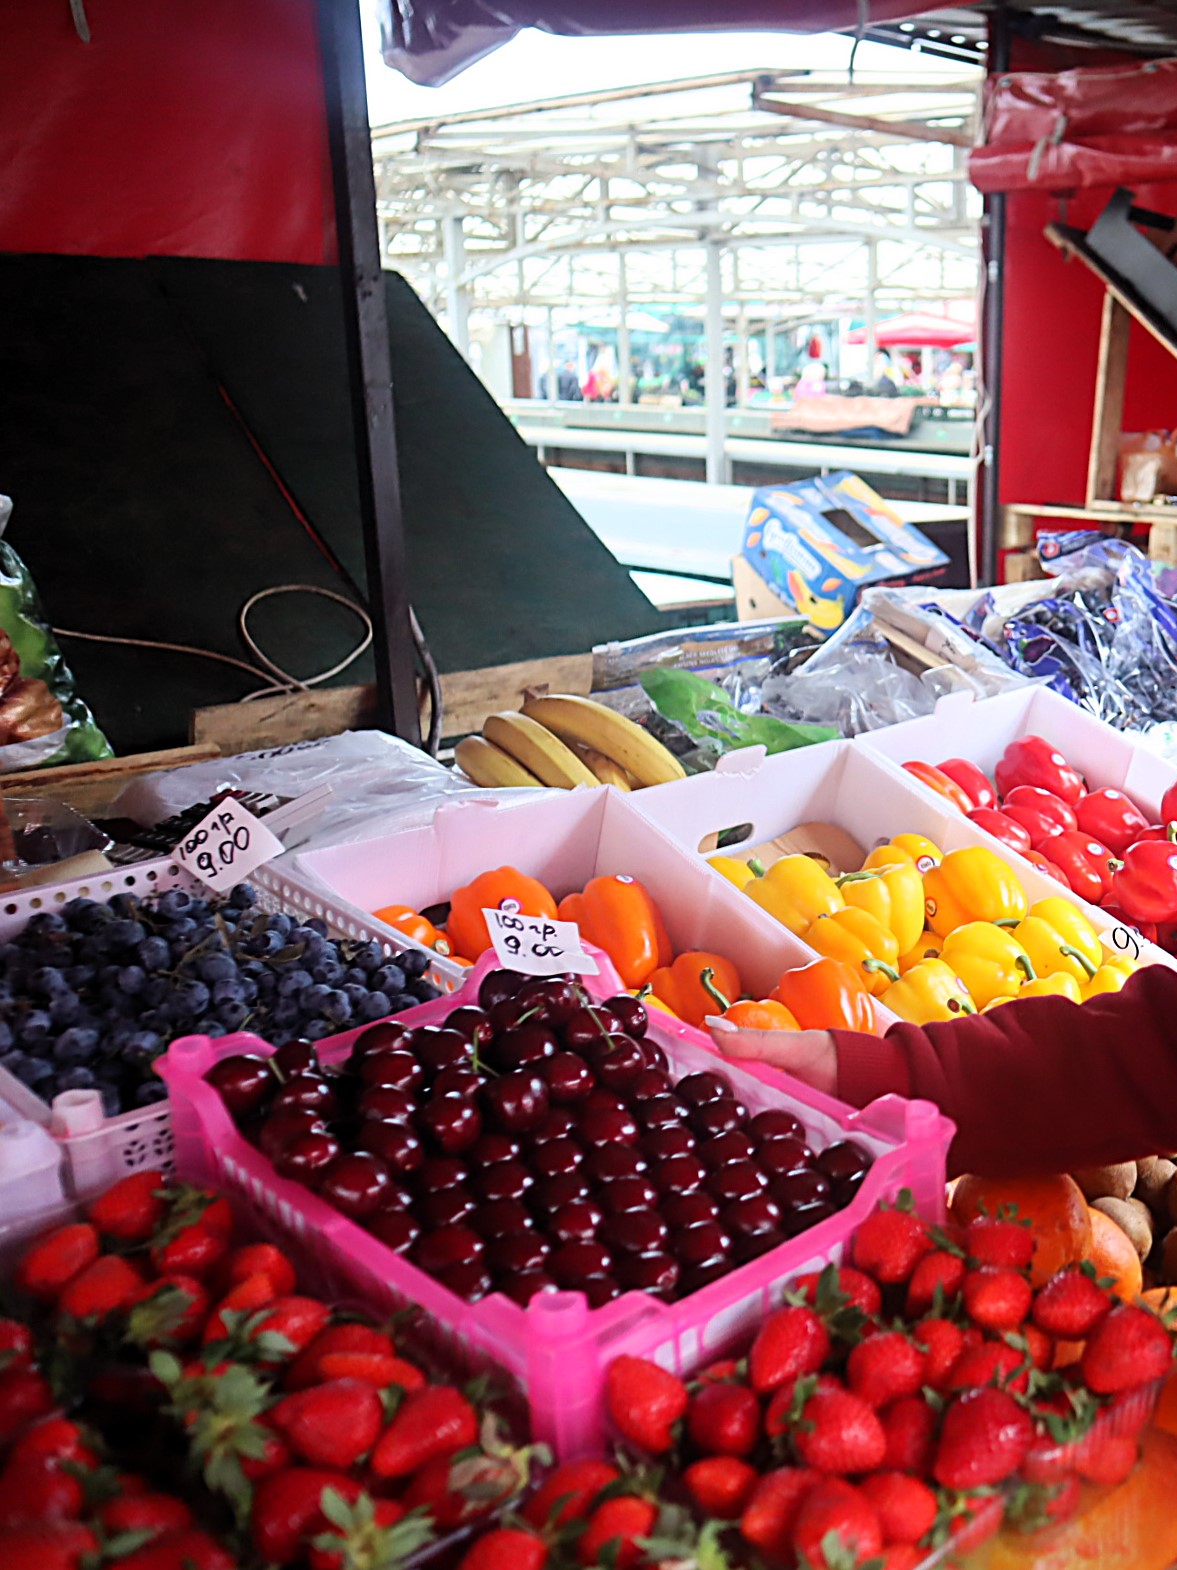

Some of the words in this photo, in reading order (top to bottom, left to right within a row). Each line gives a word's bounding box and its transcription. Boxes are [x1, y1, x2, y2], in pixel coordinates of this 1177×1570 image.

[179, 830, 208, 860] 100
[197, 827, 250, 878] 9.00
[494, 912, 524, 931] 100
[504, 935, 565, 957] 9.00
